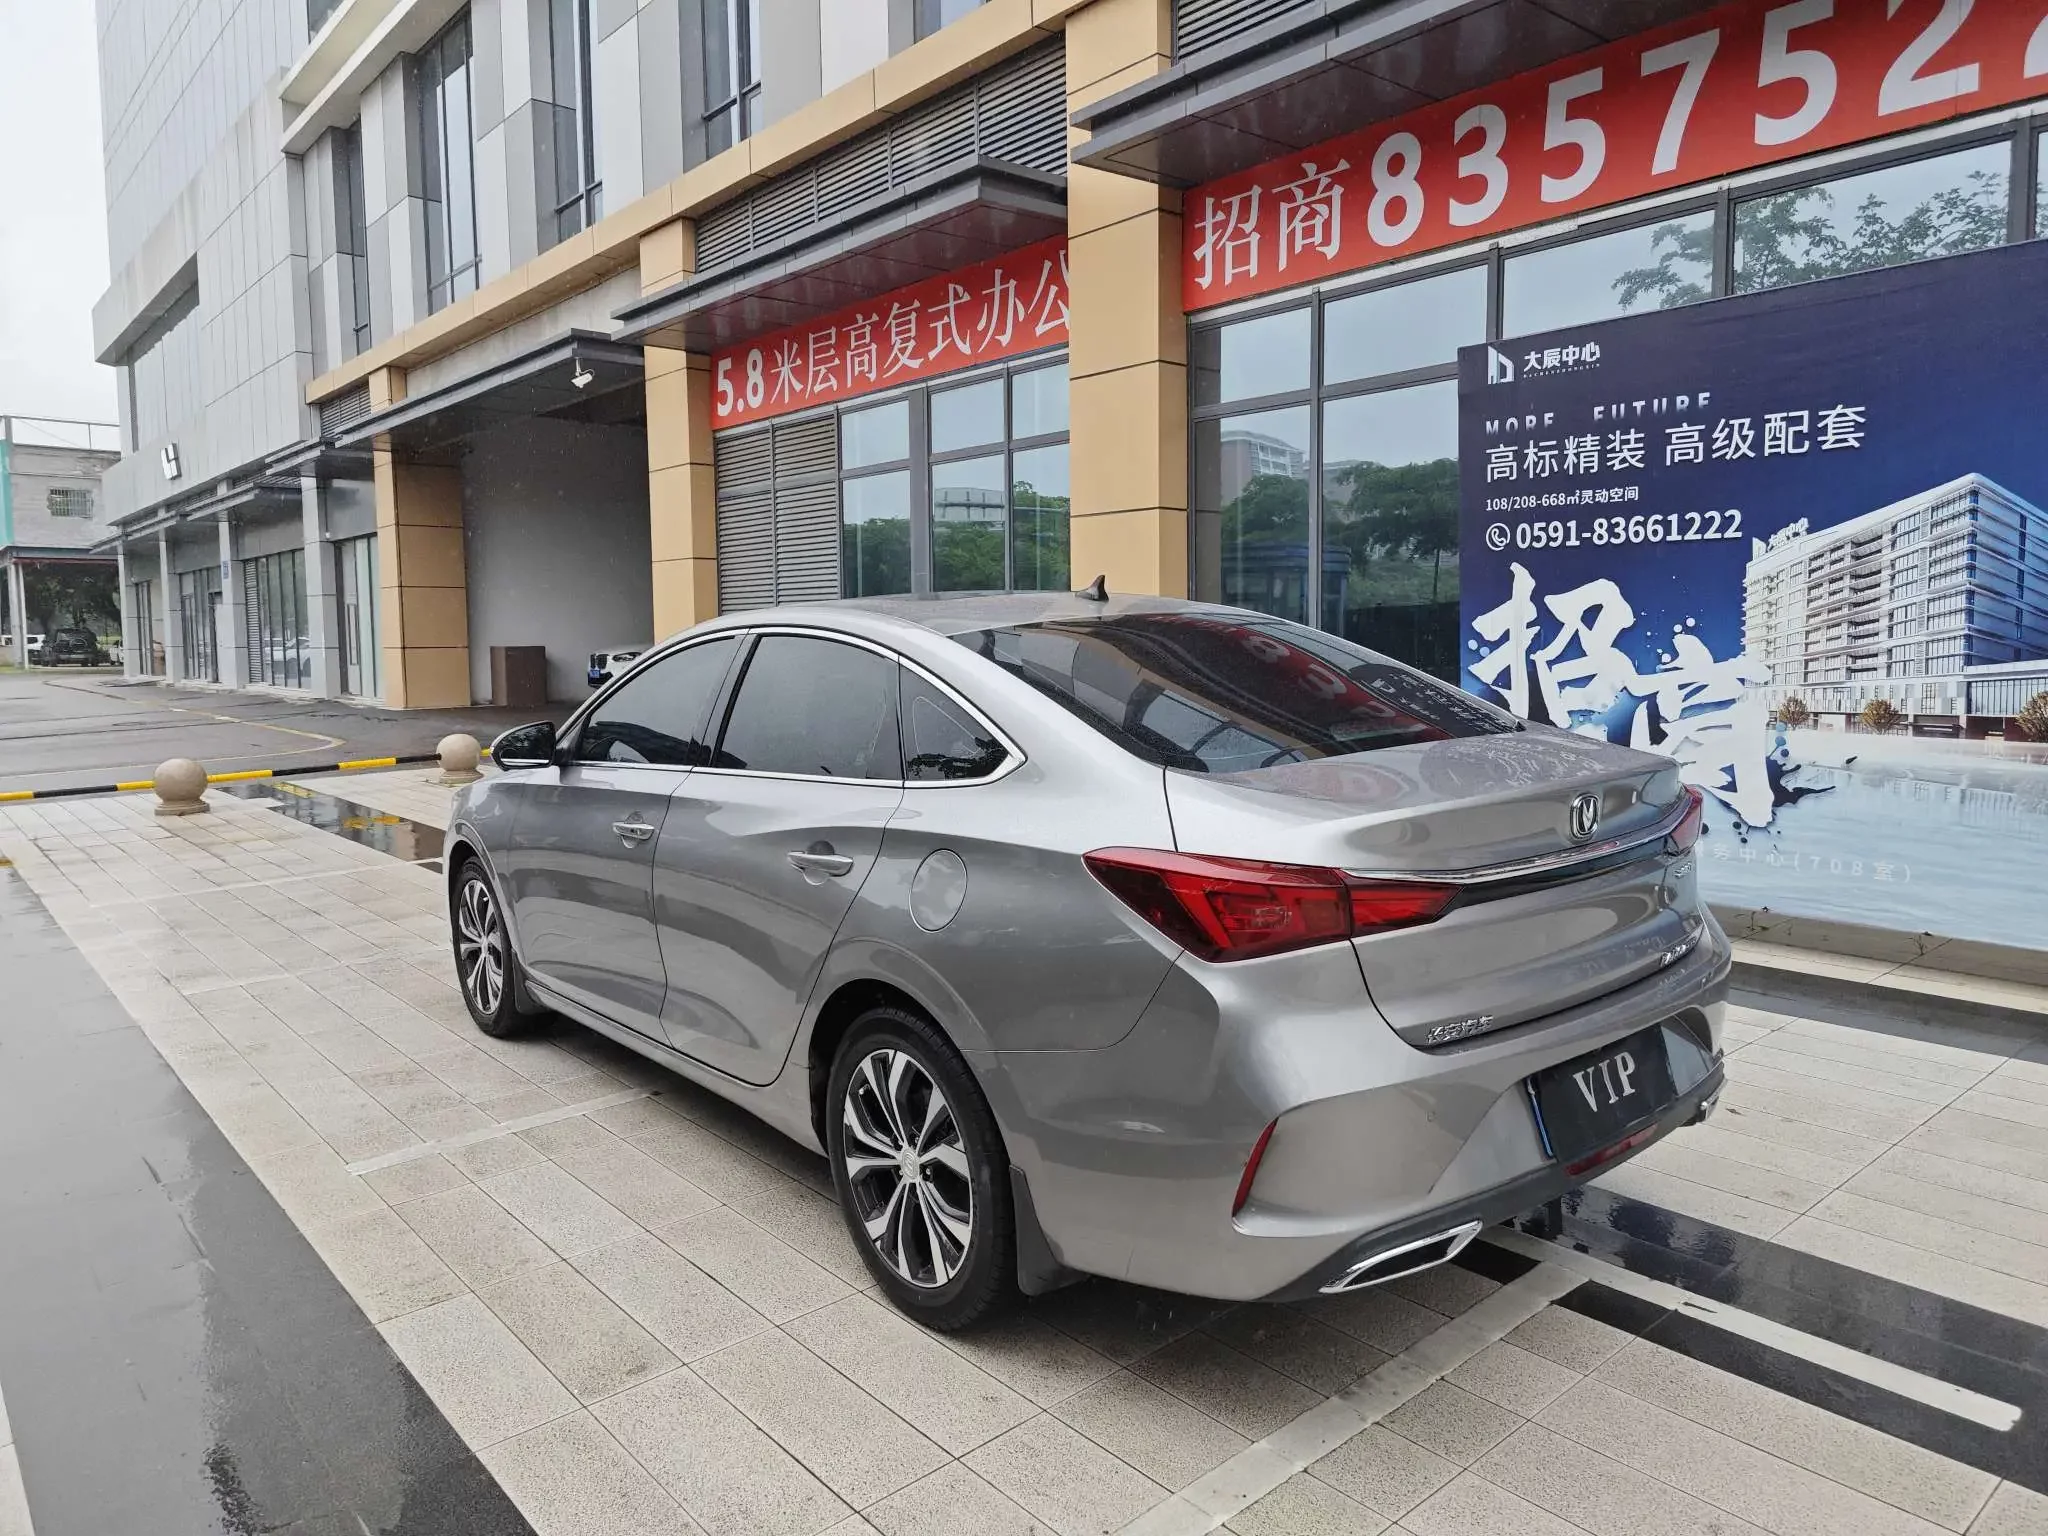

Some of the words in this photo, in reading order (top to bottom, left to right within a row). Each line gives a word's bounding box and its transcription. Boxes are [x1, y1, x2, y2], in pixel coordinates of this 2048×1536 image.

[1193, 0, 2048, 290] 招商835752
[1523, 341, 1600, 372] 大辰中心
[1485, 412, 1554, 434] MORE
[1593, 392, 1710, 421] FUTURE
[1485, 428, 1645, 483] 高标精装
[1665, 404, 1866, 466] 高级配套
[1516, 509, 1743, 549] 0591-83661222
[1573, 1052, 1635, 1112] VIP
